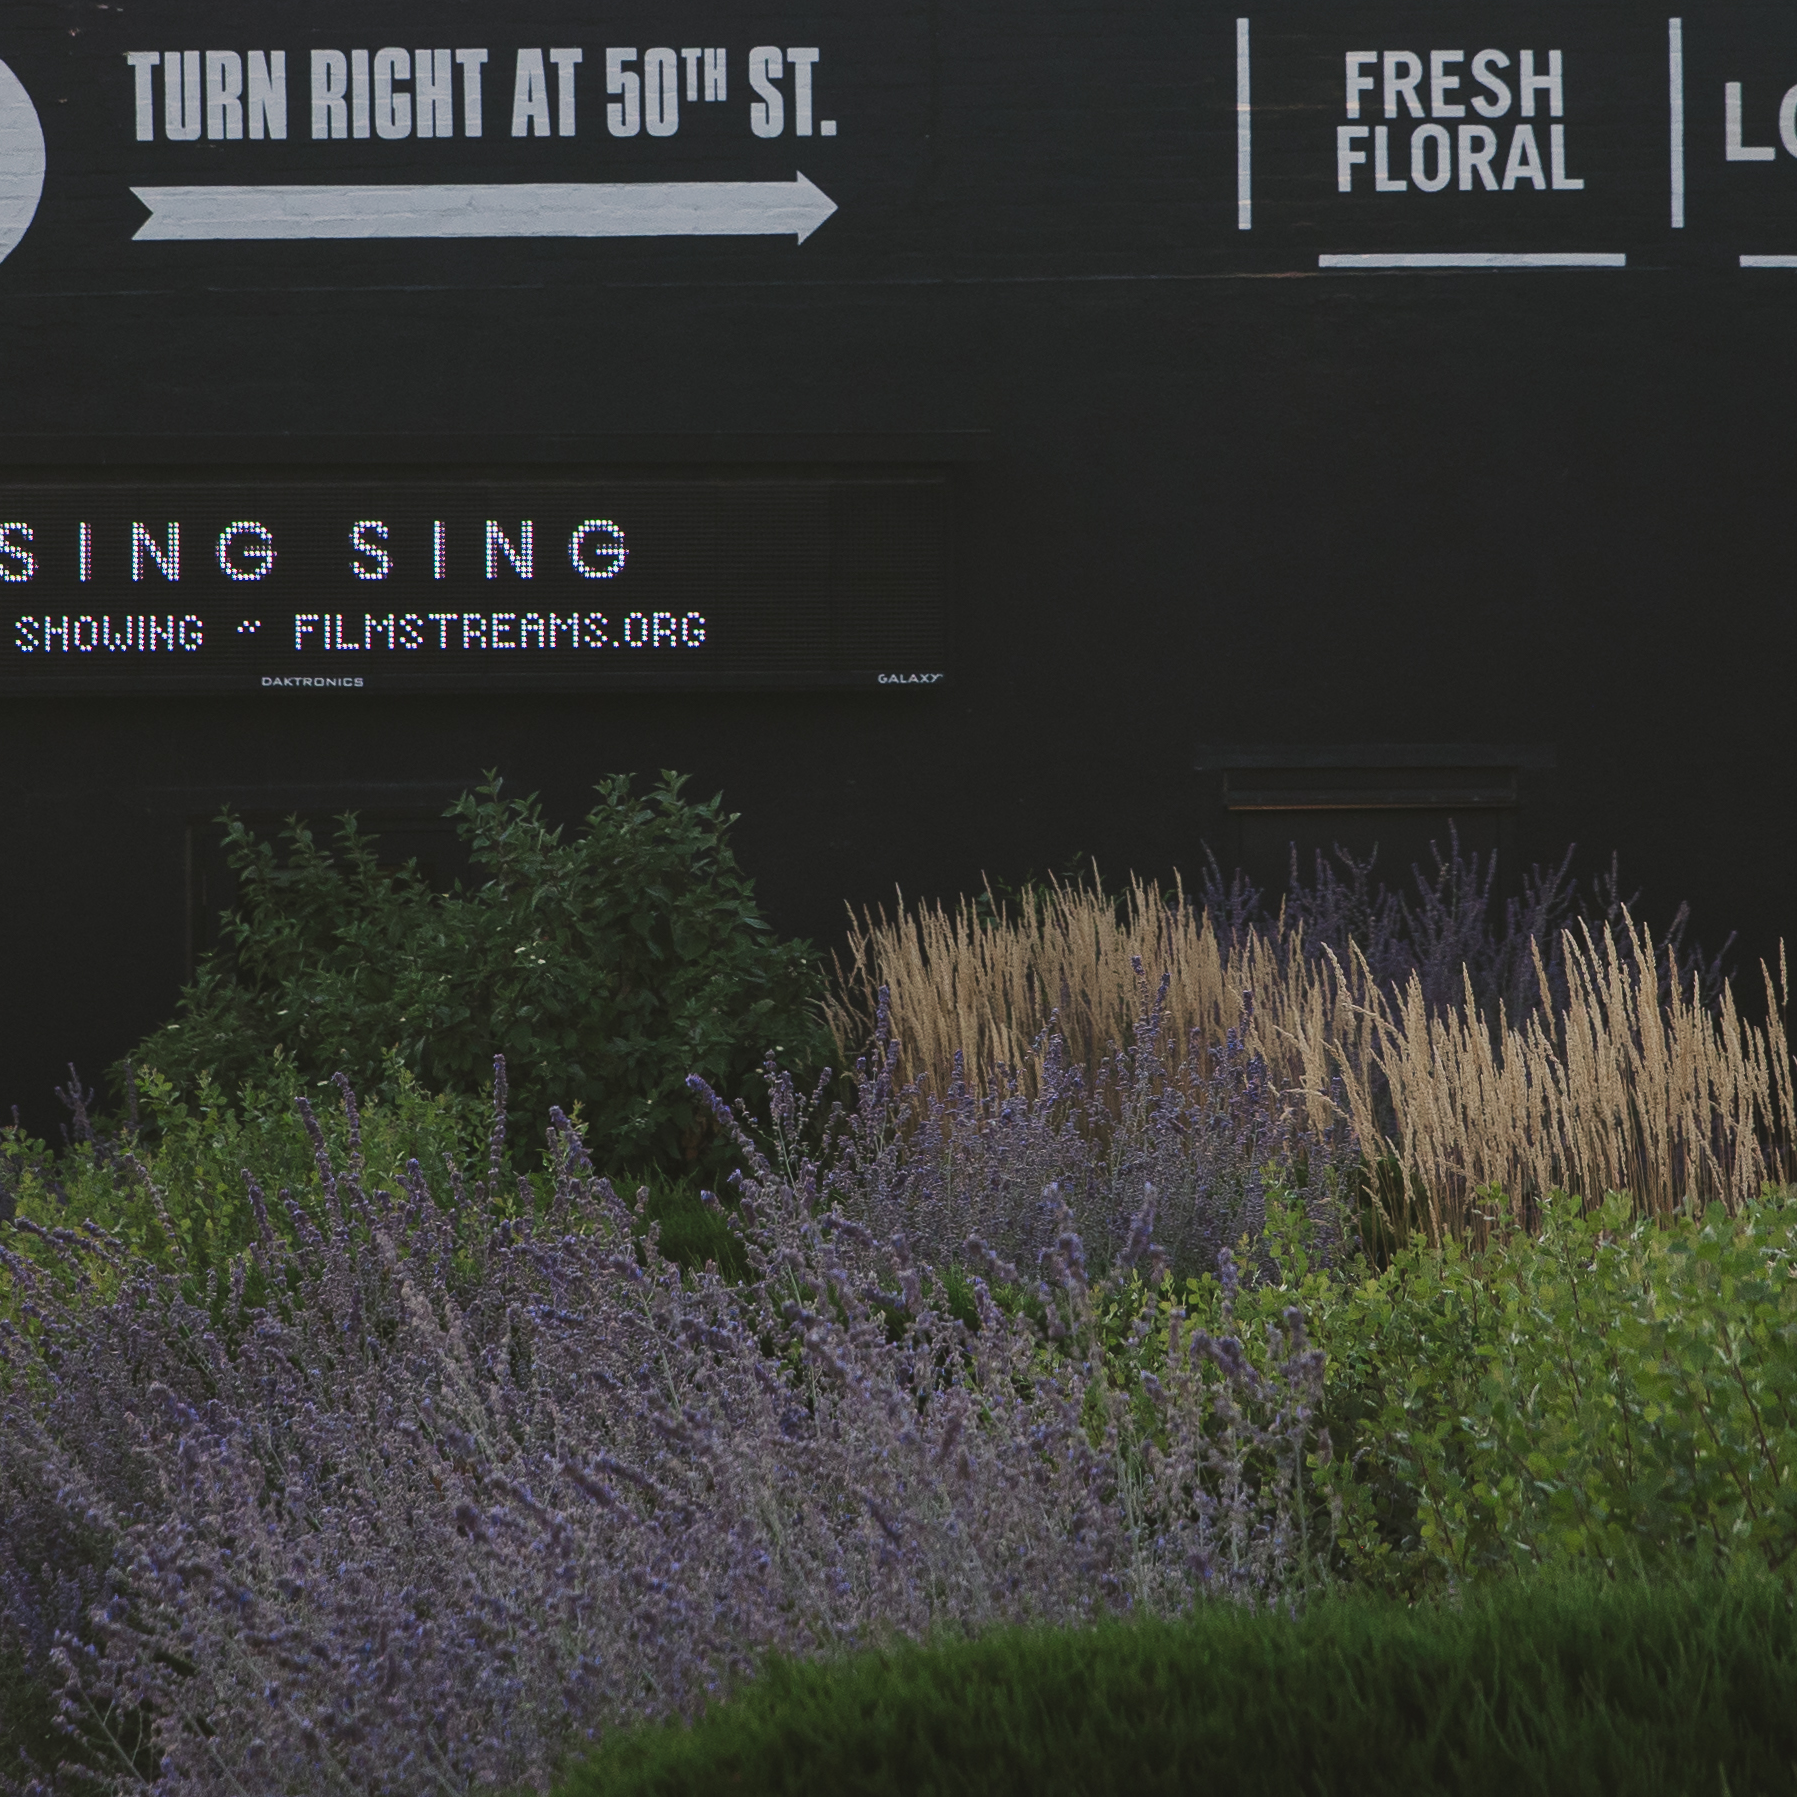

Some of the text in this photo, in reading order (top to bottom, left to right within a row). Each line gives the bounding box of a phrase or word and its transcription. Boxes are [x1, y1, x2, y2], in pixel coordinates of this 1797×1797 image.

[126, 44, 838, 142] TURN RIGHT AT 50TH ST.
[1344, 48, 1565, 119] FRESH
[1336, 123, 1586, 192] FLORAL
[348, 519, 631, 581] SING
[14, 614, 204, 653] SHOWING
[294, 611, 707, 651] FILMSTREAMS.ORG
[261, 677, 364, 687] DAKTRONICS
[877, 673, 943, 684] GALAXY
